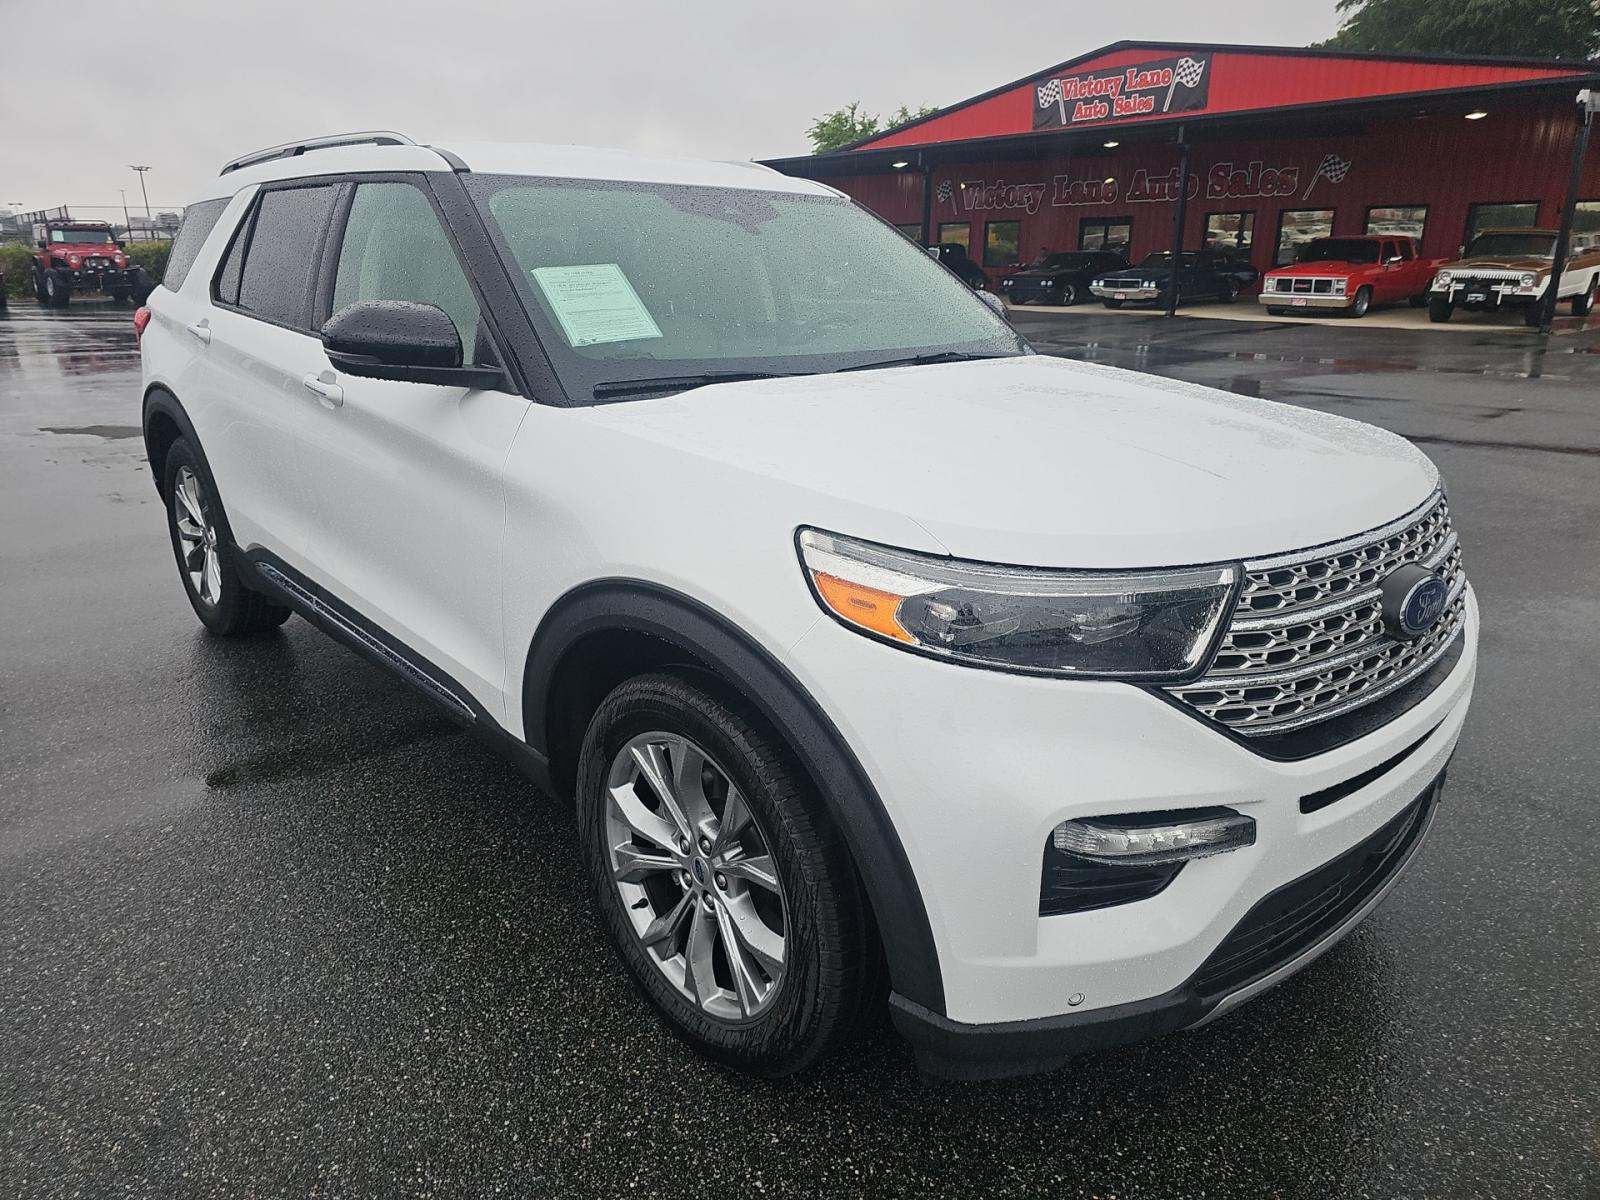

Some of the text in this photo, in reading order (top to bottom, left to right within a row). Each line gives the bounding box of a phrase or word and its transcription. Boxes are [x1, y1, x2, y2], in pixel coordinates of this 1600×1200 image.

[1061, 68, 1172, 100] Victory Lane
[1072, 94, 1154, 121] Auto Sales
[962, 180, 1045, 214] Victory
[1052, 175, 1118, 206] Lane
[1207, 161, 1298, 199] Sales
